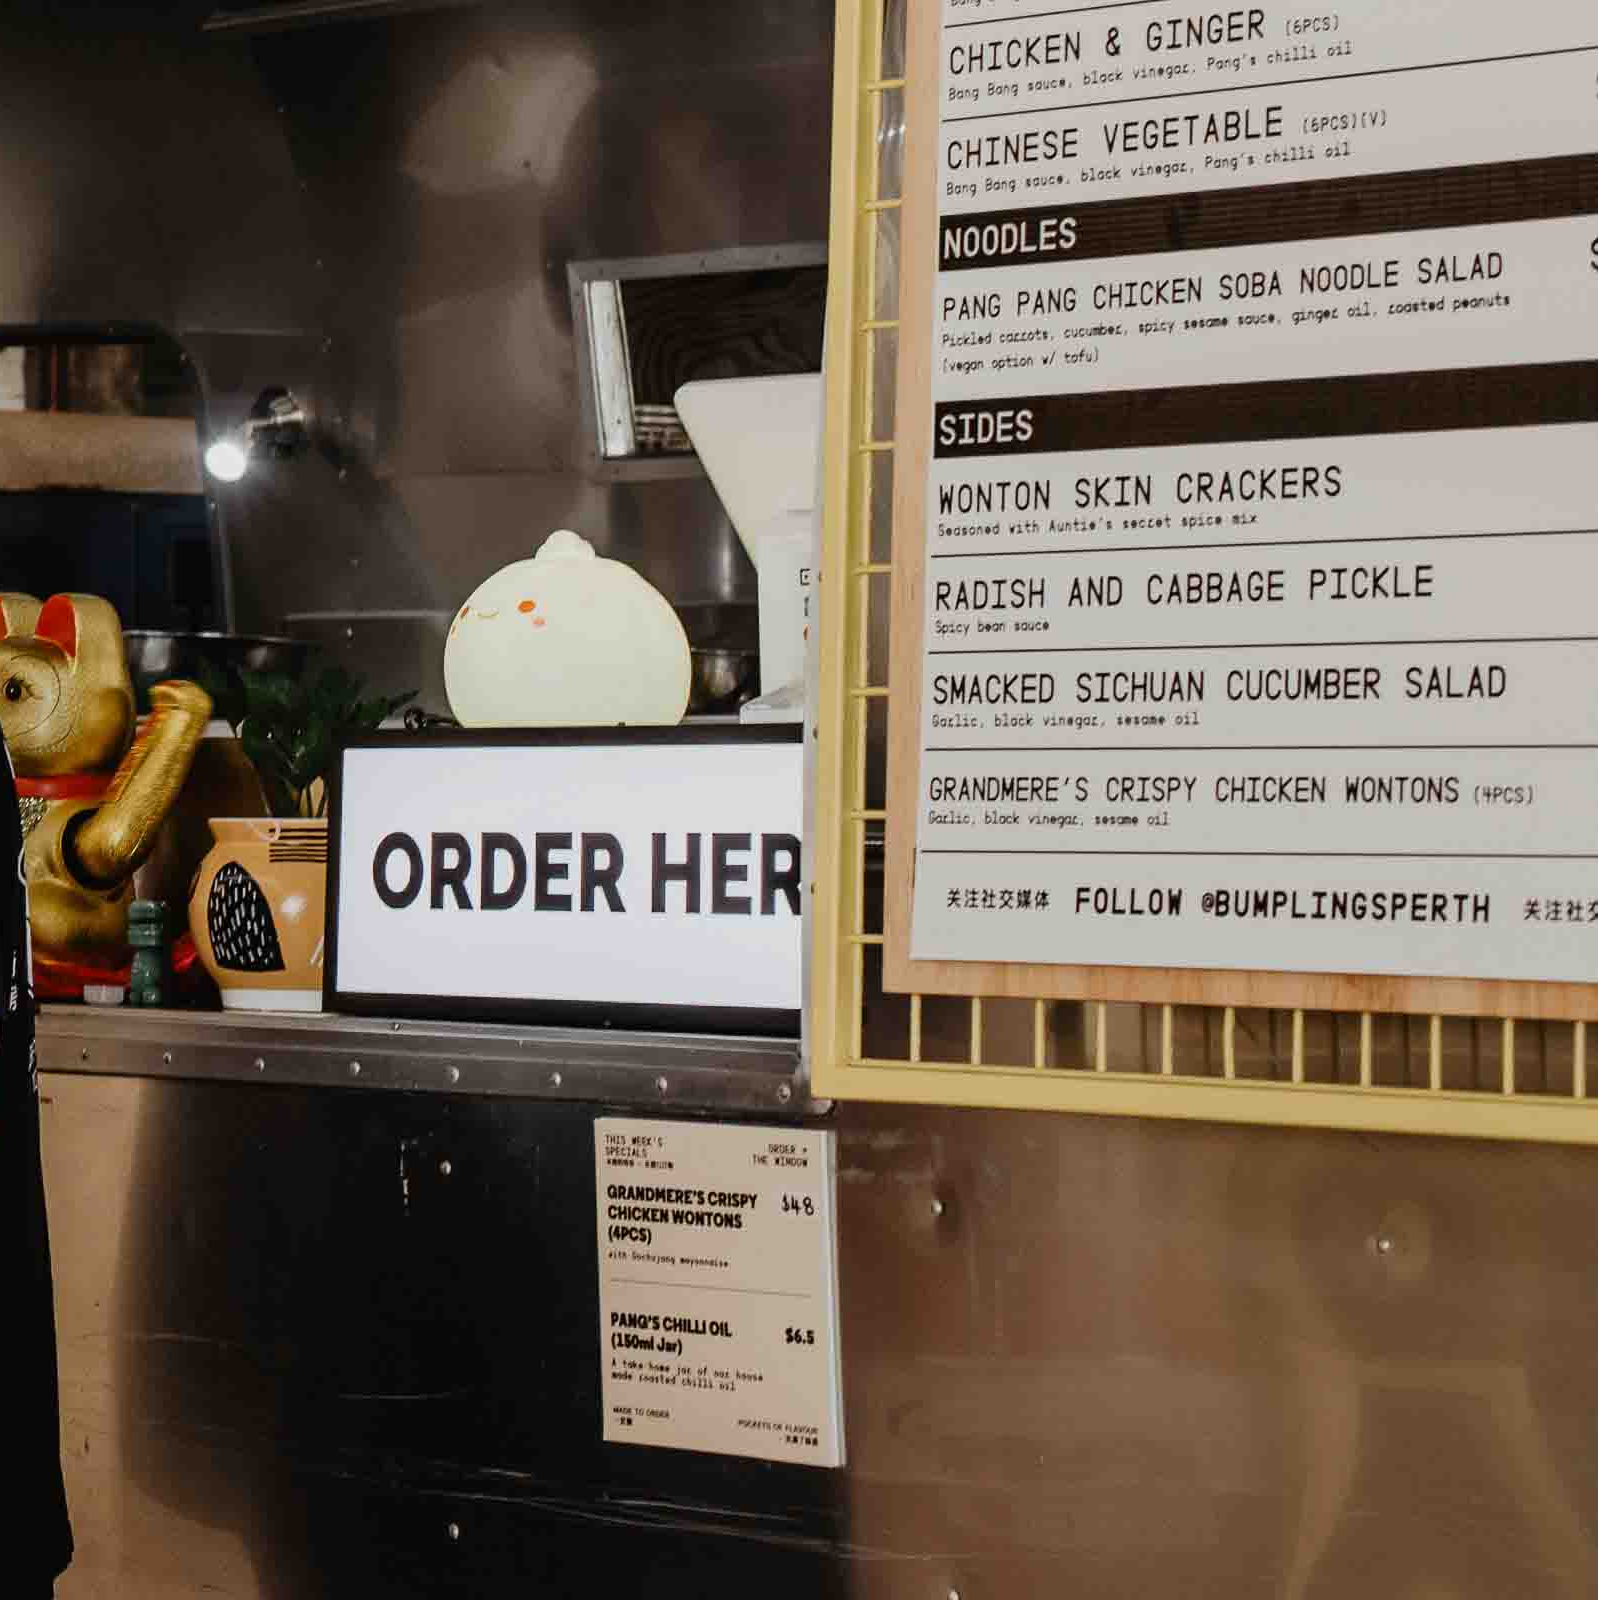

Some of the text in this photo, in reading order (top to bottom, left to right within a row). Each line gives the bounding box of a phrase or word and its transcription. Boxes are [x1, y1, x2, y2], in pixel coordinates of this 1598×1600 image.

[950, 31, 1080, 75] CHICKEN
[1105, 26, 1121, 57] &
[1146, 9, 1265, 52] GINGER
[948, 87, 979, 101] Bang
[987, 82, 1019, 97] Bang
[1083, 70, 1123, 85] black
[1207, 53, 1256, 72] Pang's
[1267, 45, 1317, 64] chilli
[1327, 40, 1352, 57] oil
[948, 128, 1078, 170] CHINESE
[1103, 105, 1282, 155] VEGETABLE
[946, 181, 977, 198] Bang
[985, 177, 1016, 193] Bang
[1081, 166, 1121, 182] black
[1204, 152, 1255, 172] Pang's
[1264, 146, 1315, 164] chilli
[1325, 141, 1351, 160] oil
[943, 217, 1077, 259] NOODLES
[943, 252, 1503, 321] PANG PANG CHICKEN SOBA NOODLE SALAD
[942, 331, 992, 347] Pickled
[1139, 322, 1175, 336] spicy
[1183, 317, 1229, 330] sesame
[1291, 308, 1338, 326] ginger
[1387, 296, 1445, 315] roasted
[1452, 292, 1510, 312] peanuts
[991, 355, 1033, 371] option
[1041, 351, 1056, 365] w/
[935, 409, 1033, 446] SIDES
[939, 465, 1342, 515] WONTON SKIN CRACKERS
[938, 513, 1257, 537] Seasoned with Auntie's secret spice mix
[936, 564, 1433, 611] RADISH AND CABBAGE PICKLE
[935, 619, 1050, 636] Spicy bean sauce
[933, 665, 1506, 705] SMACKED SICHUAN CUCUMBER SALAD
[994, 712, 1033, 727] black
[1117, 715, 1166, 726] sesame
[1175, 711, 1200, 726] oil
[929, 776, 1089, 802] GRANDMERE'S
[1106, 776, 1197, 802] CRISPY
[1215, 776, 1326, 803] CHICKEN
[1345, 776, 1459, 804] WONTONS
[984, 810, 1020, 825] black
[1095, 816, 1139, 826] sesame
[1147, 811, 1169, 826] oil
[372, 832, 626, 913] ORDER
[1075, 887, 1183, 916] FOLLOW
[1201, 889, 1490, 923] @BUMPLINGSPERTH
[607, 1185, 757, 1209] GRANDMERE'S CRISPY
[608, 1205, 743, 1229] CHICKEN WONTONS
[608, 1226, 652, 1245] (4PCS)
[611, 1312, 732, 1338] PANG'S CHILLI OIL
[784, 1327, 815, 1345] $6.5
[657, 1338, 683, 1356] Jar)
